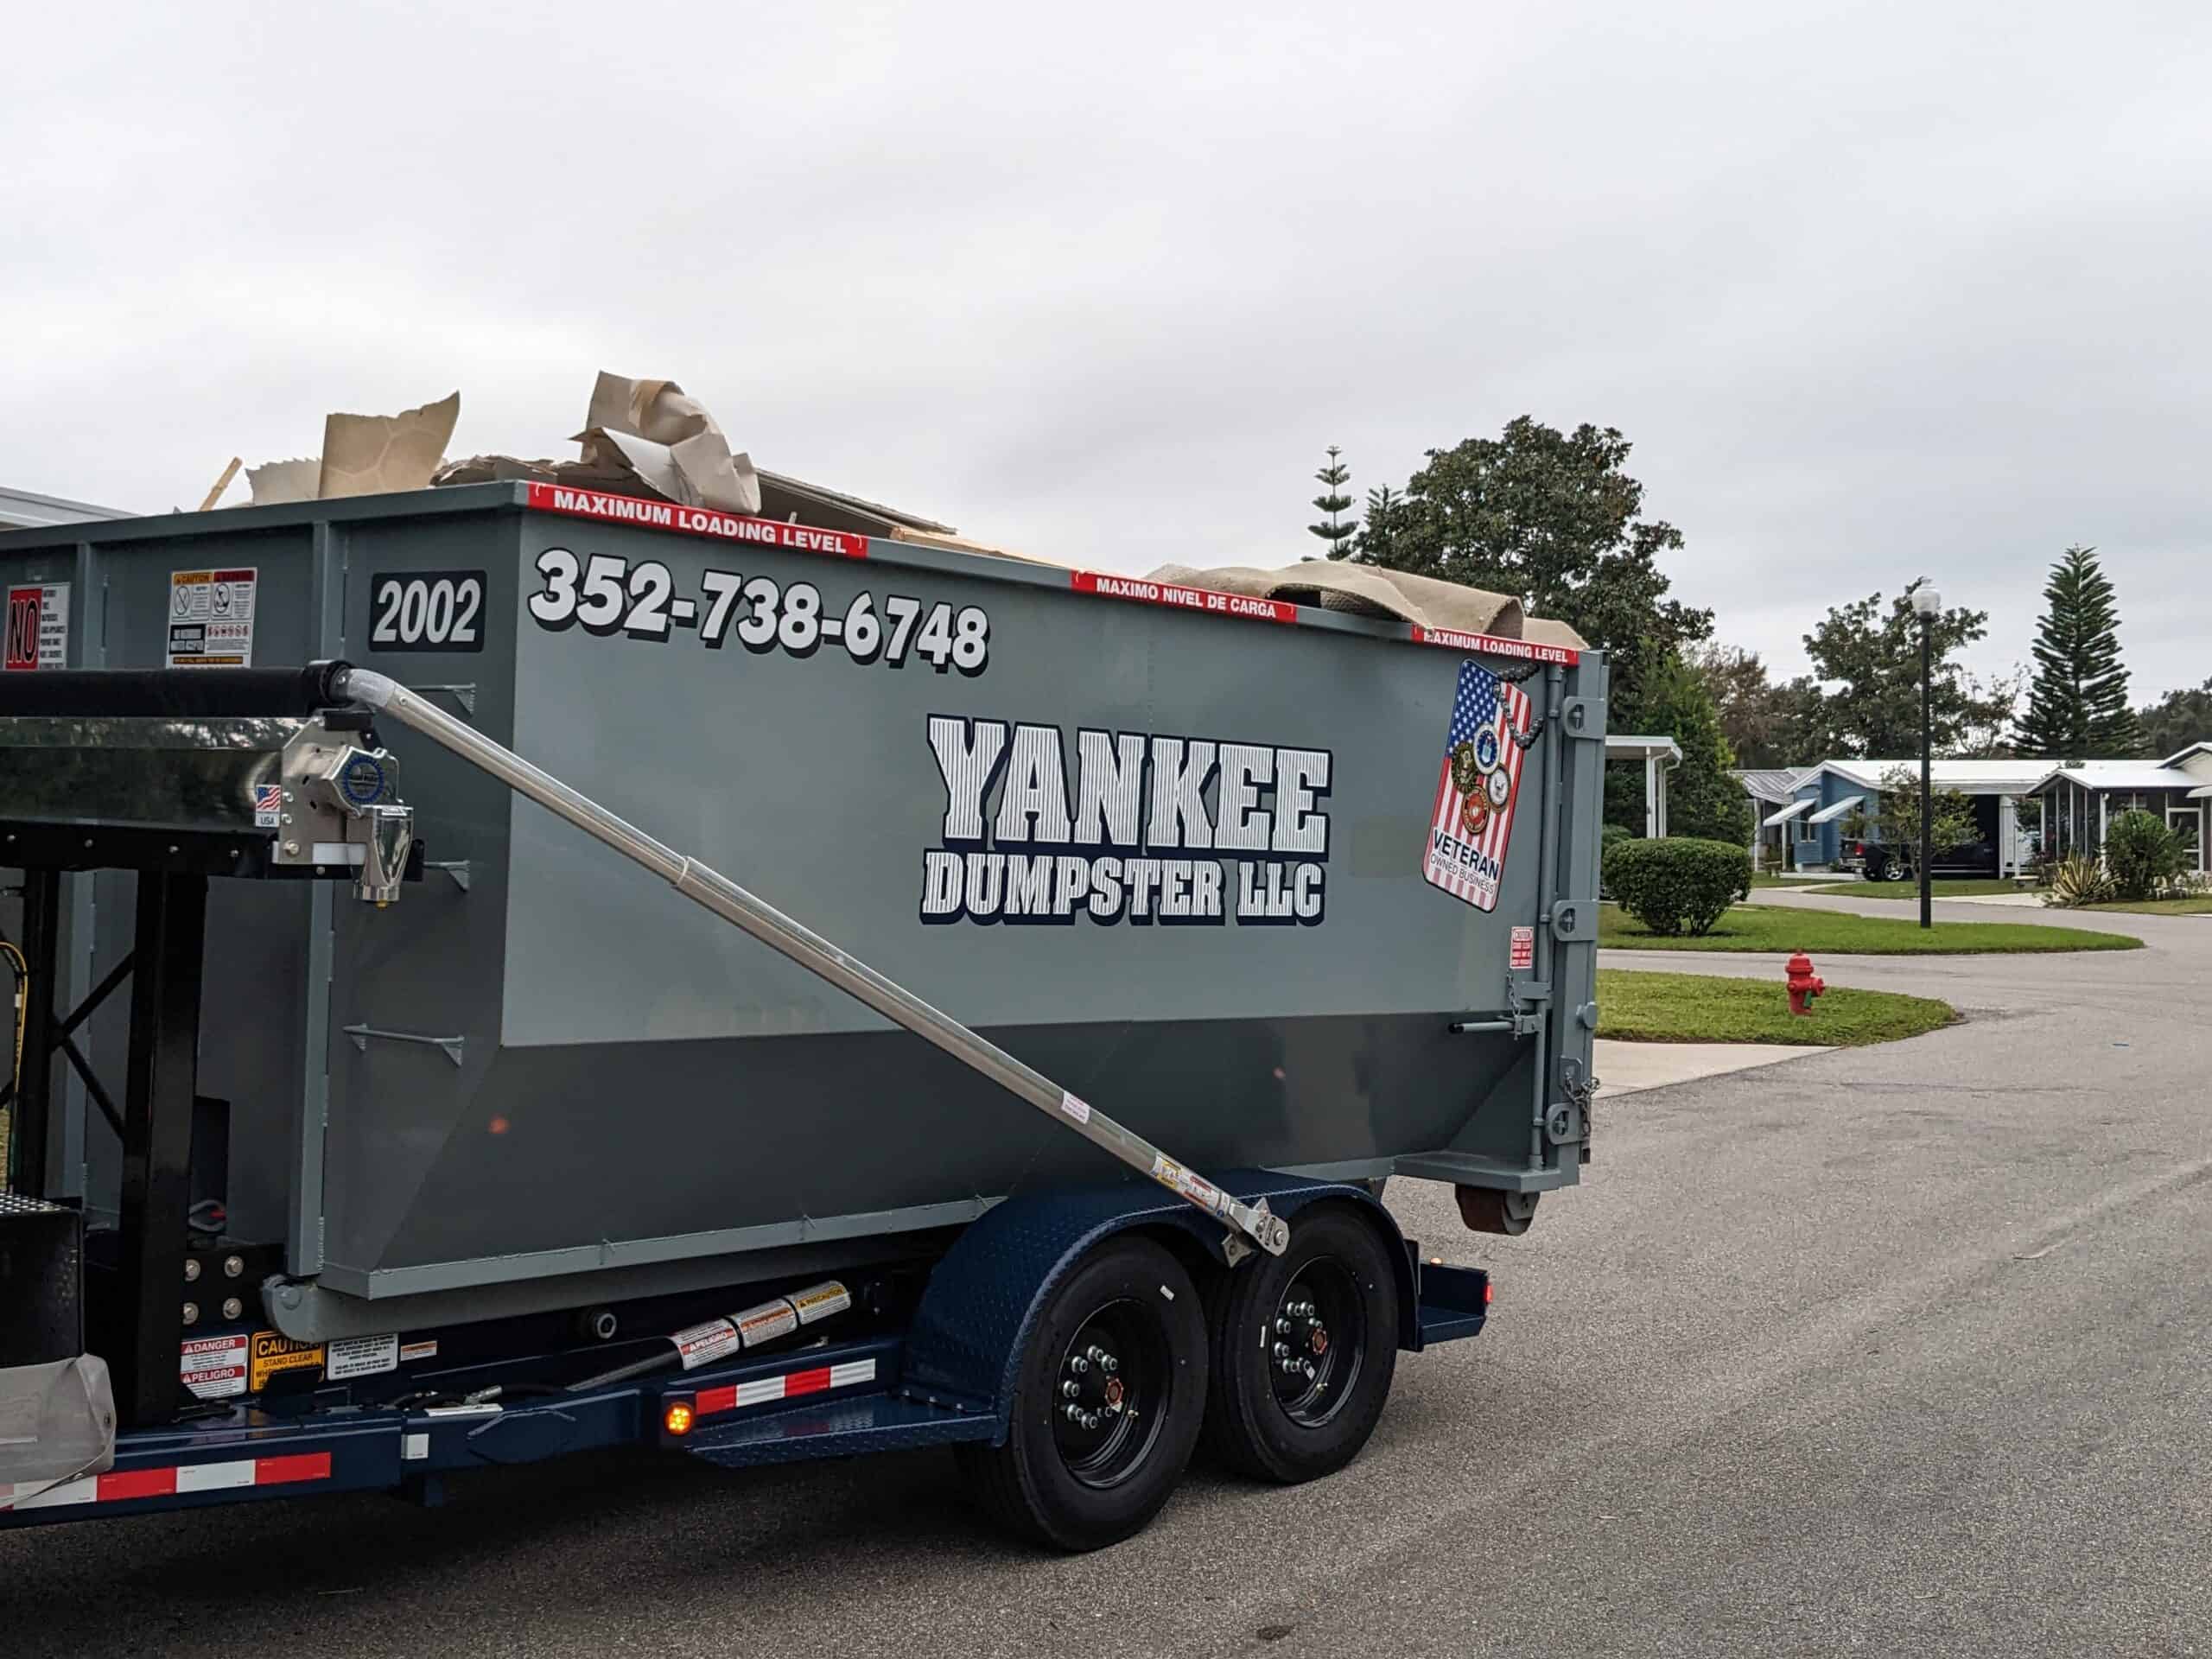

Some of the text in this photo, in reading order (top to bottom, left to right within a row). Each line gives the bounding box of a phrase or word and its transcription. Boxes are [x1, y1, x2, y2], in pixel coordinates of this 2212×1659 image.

[554, 490, 847, 554] MAXIMUM LOADING LEVEL
[373, 578, 481, 643] 2002
[527, 547, 989, 676] 352-738-6748
[1096, 577, 1277, 618] MAXIMO NIVEL DE CARGA
[7, 598, 39, 663] NO
[1483, 640, 1533, 658] LOADING
[1535, 649, 1568, 663] LEVEL
[927, 714, 1333, 859] YANKEE
[260, 817, 275, 825] USA
[1431, 854, 1494, 894] OWNED BUSINESS
[1434, 830, 1499, 880] VETERAN
[919, 849, 1325, 925] DUMPSTER LLC
[194, 1339, 235, 1352] DANGER
[263, 1357, 288, 1367] STAND
[289, 1354, 313, 1363] CLEAR
[193, 1369, 236, 1382] PELIGRO
